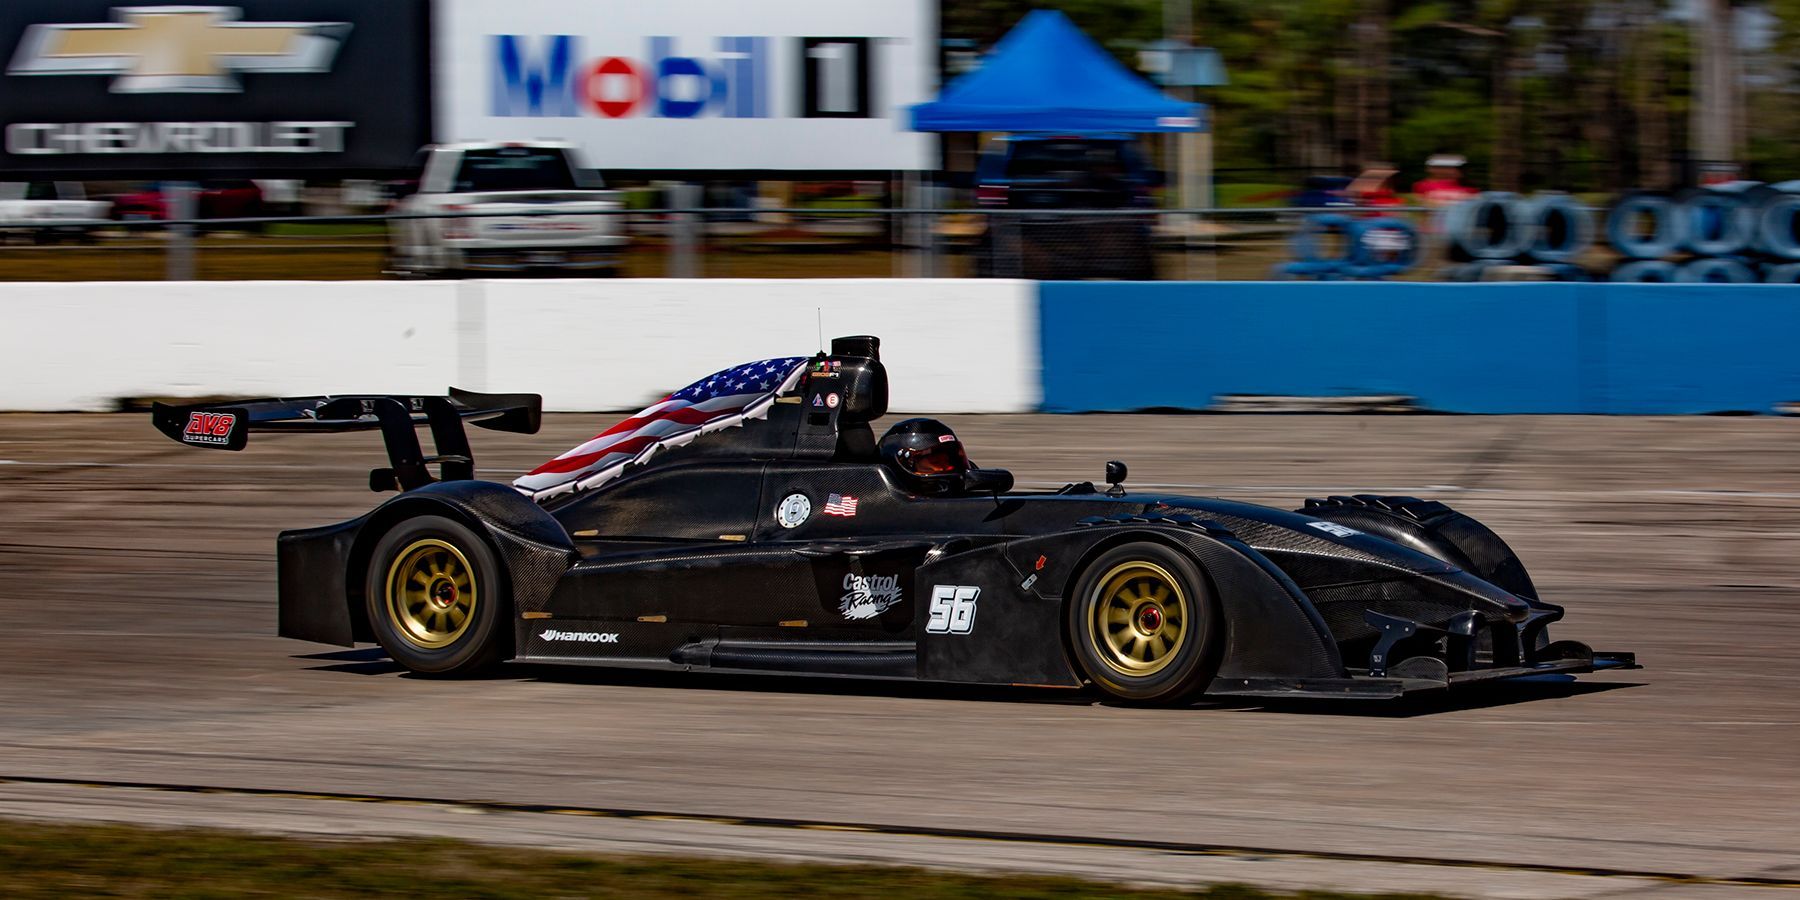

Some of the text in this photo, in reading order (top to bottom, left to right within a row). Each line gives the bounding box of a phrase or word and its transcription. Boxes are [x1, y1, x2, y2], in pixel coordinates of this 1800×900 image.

[486, 35, 774, 117] Mobil
[5, 122, 353, 154] CHEVROLET
[185, 413, 235, 436] AV8
[184, 434, 228, 443] SUPERCARS
[843, 573, 898, 592] Castrol
[845, 592, 893, 609] Racing
[926, 585, 981, 635] 56
